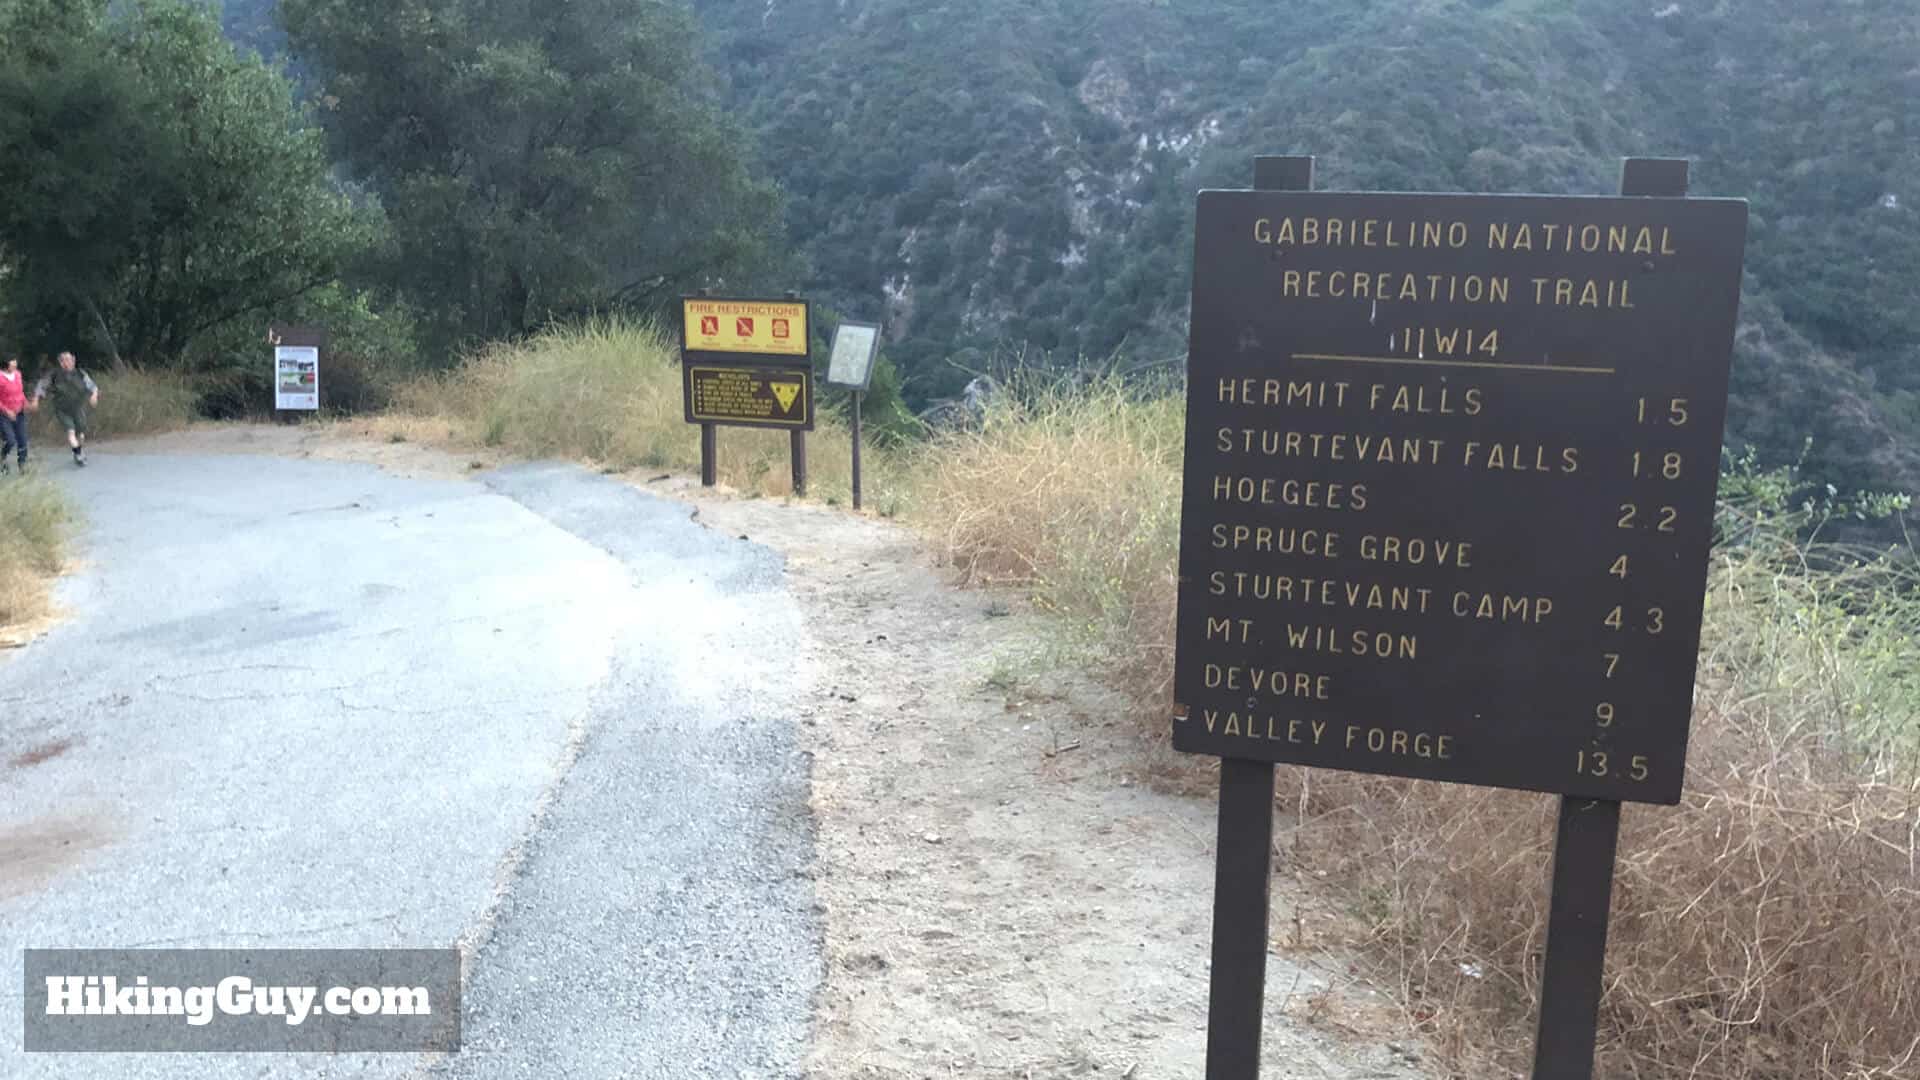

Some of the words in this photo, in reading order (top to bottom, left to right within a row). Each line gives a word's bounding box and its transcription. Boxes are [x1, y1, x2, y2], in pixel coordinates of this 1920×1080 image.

[1254, 217, 1468, 248] GABRIELINO
[1488, 223, 1677, 255] NATIONAL
[1282, 270, 1510, 304] RECREATION
[1532, 278, 1637, 308] TRAIL
[689, 304, 715, 313] FIRE
[718, 304, 800, 317] RESTRICTIONS
[1403, 328, 1500, 358] 11W14
[1217, 378, 1350, 409] HERMIT
[1369, 384, 1483, 416] FALLS
[1216, 428, 1445, 465] STURTEVANT
[1464, 442, 1579, 473] FALLS
[1213, 477, 1368, 511] HOEGEES
[1211, 524, 1340, 558] SPRUCE
[1360, 535, 1474, 568] GROVE
[1609, 555, 1629, 579] 4
[1209, 571, 1432, 613] STURTEVANT
[1452, 591, 1553, 624] CAMP
[1288, 624, 1418, 660] WILSON
[1603, 654, 1620, 678] 7
[1204, 663, 1331, 701] DEVORE
[1595, 703, 1614, 728] 9
[1203, 710, 1328, 745] VALLEY
[1345, 725, 1454, 760] FORGE
